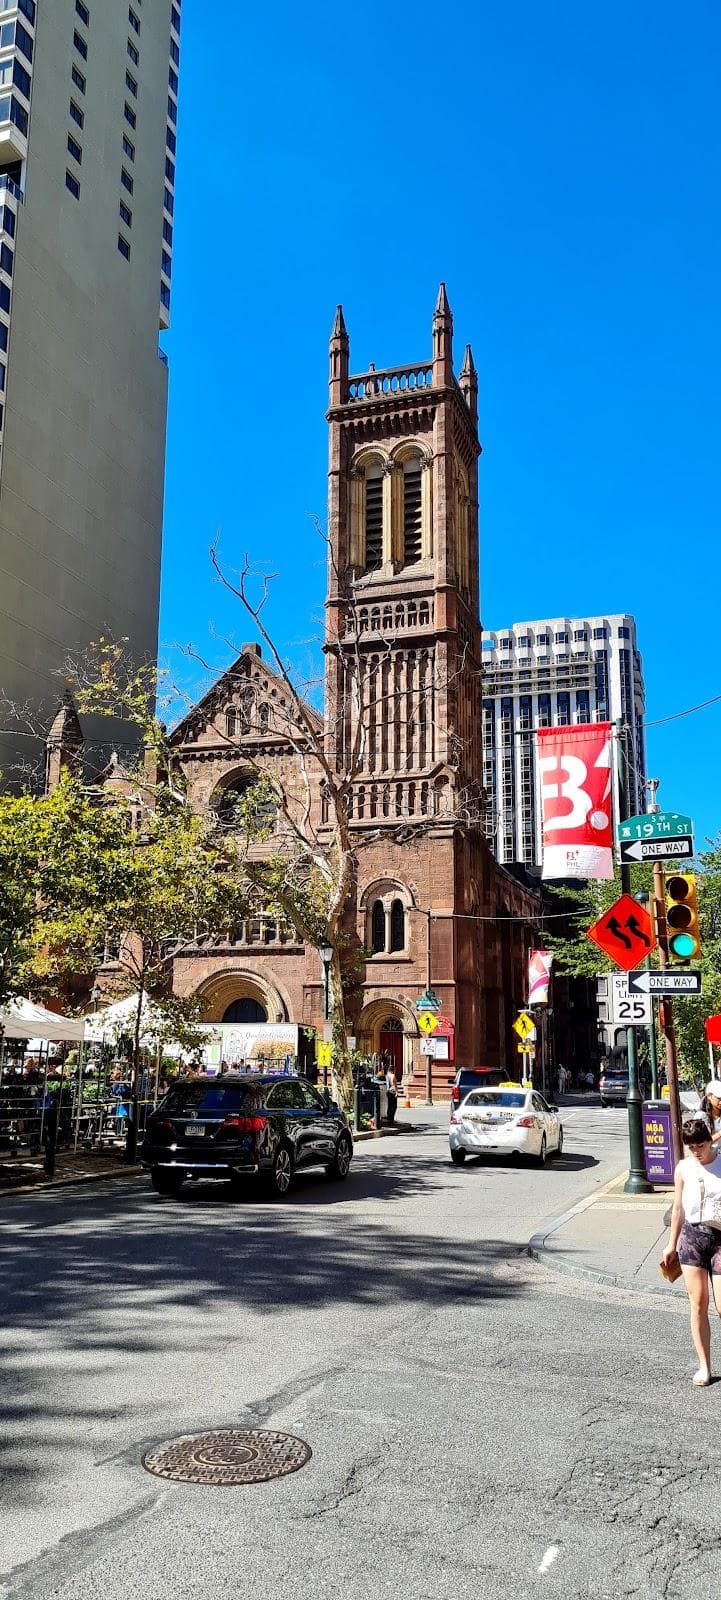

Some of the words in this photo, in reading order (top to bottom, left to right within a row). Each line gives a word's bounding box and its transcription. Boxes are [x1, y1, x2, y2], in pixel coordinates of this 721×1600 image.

[676, 824, 689, 834] ST
[641, 844, 663, 855] ONE
[665, 842, 685, 854] WAY
[649, 977, 670, 987] ONE
[673, 977, 693, 987] WAY
[618, 1001, 645, 1018] 25
[645, 1123, 664, 1132] MBA
